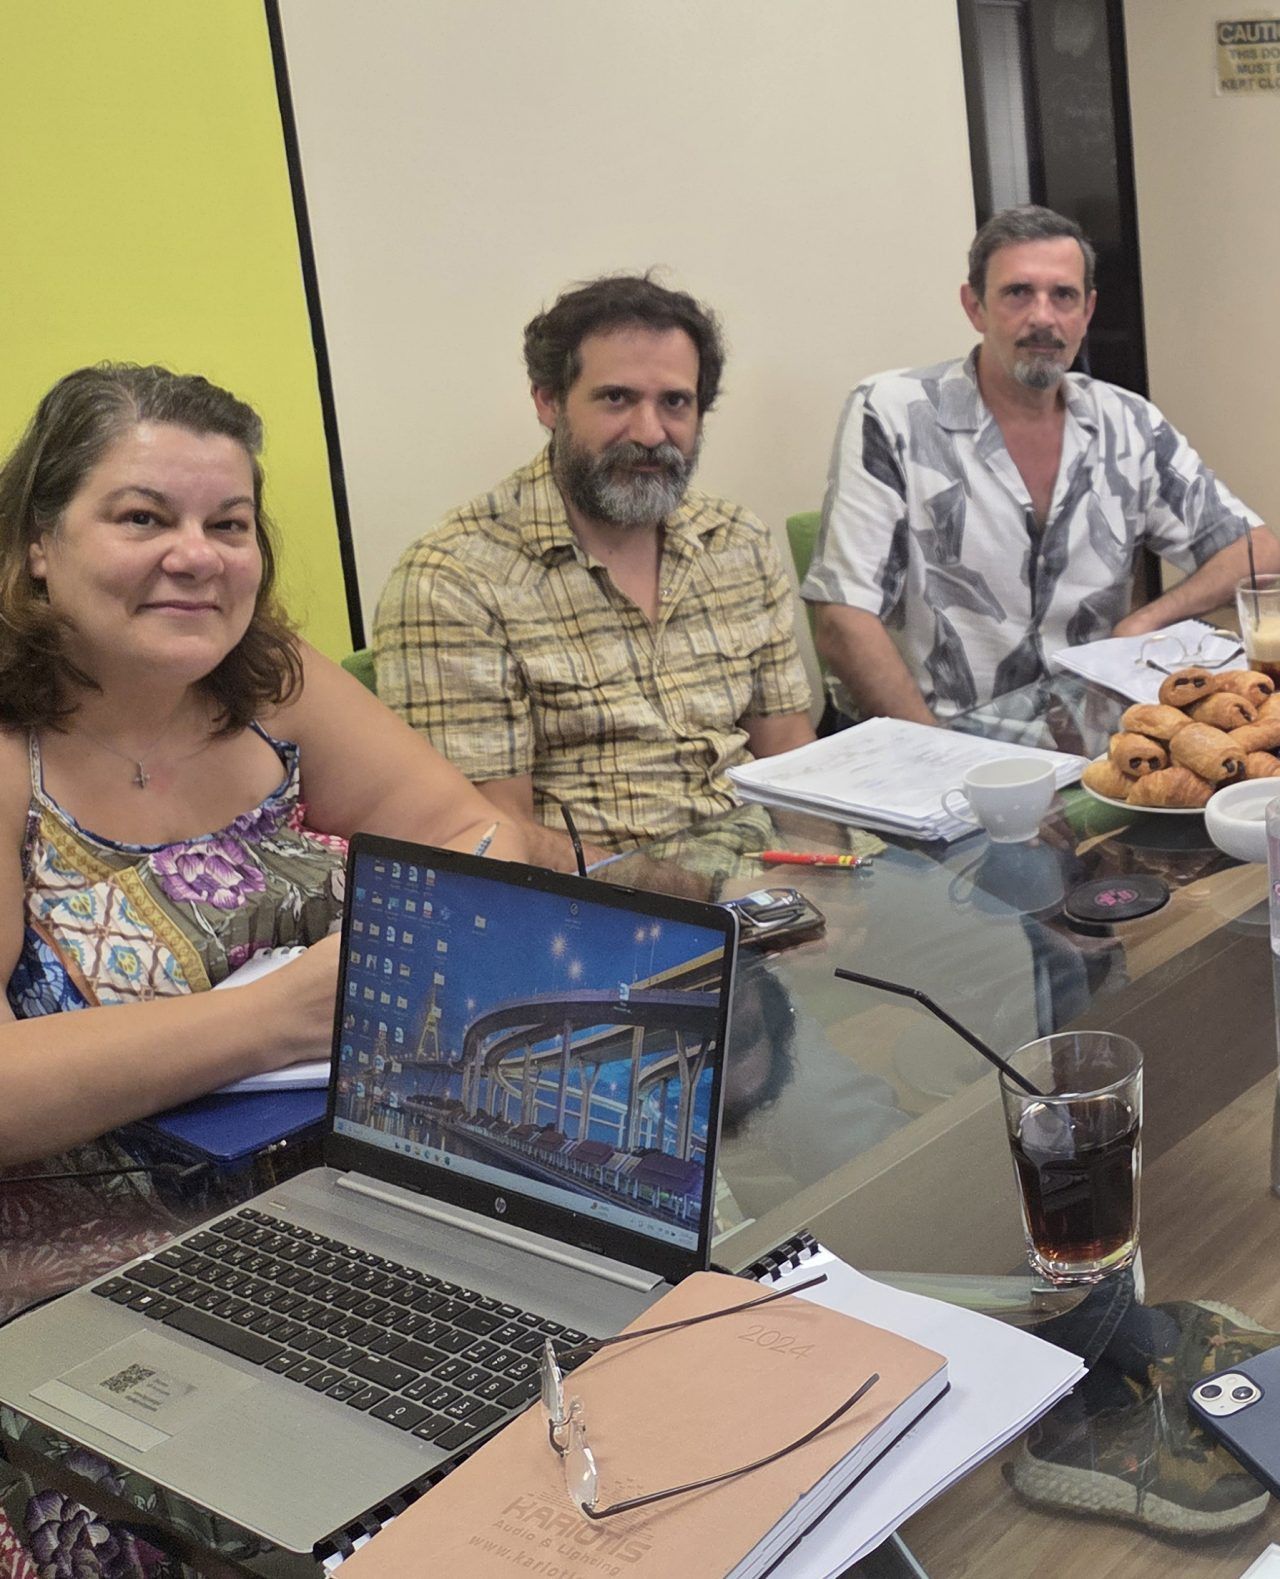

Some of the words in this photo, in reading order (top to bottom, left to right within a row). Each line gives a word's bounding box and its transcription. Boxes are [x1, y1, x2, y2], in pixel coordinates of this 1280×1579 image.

[1236, 63, 1270, 74] MUST
[737, 1324, 816, 1360] 2024
[492, 1519, 536, 1542] Audio
[557, 1543, 622, 1577] Lighting
[501, 1496, 653, 1565] KARIOTIS
